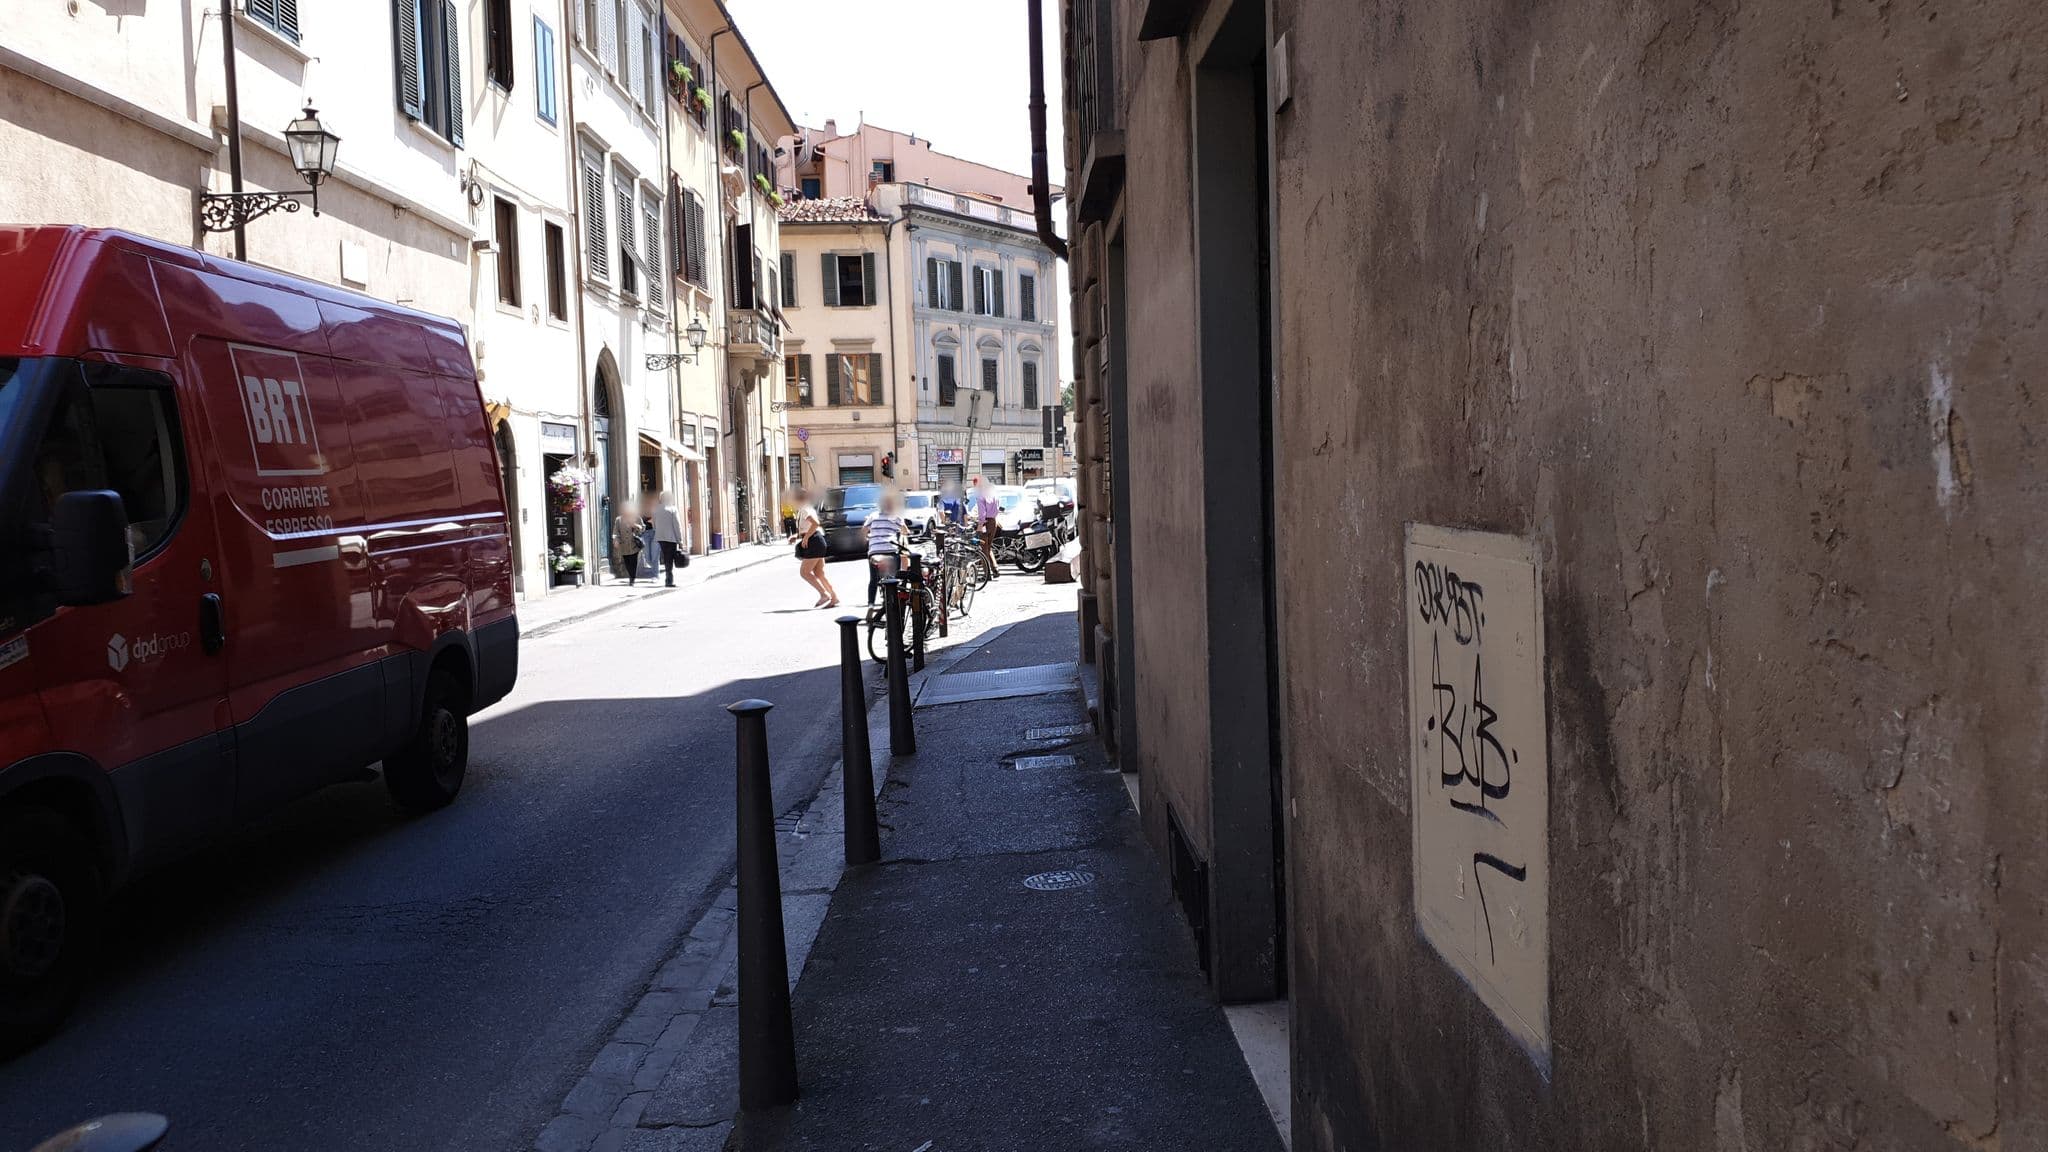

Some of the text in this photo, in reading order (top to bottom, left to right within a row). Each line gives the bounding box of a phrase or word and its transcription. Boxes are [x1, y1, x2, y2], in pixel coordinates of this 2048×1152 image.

[243, 375, 307, 444] BRT
[261, 485, 330, 511] CORRIERE
[266, 514, 333, 535] ESPRESSO
